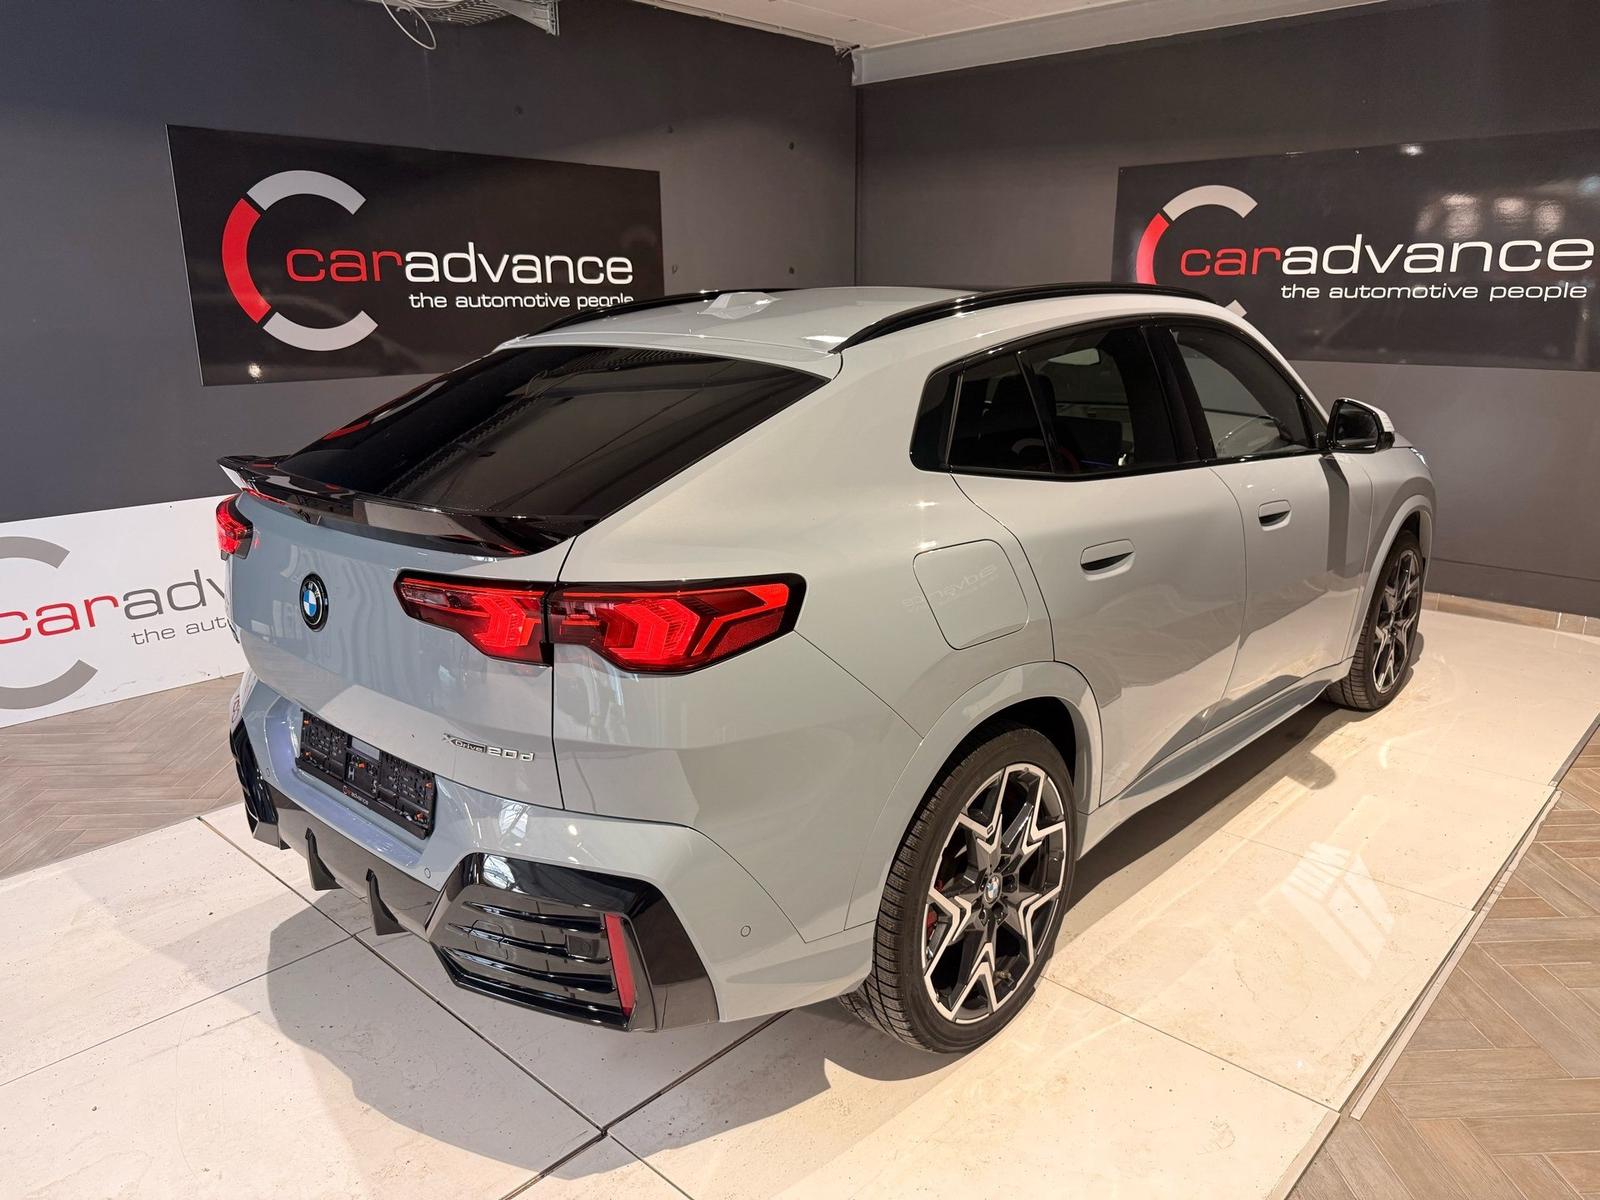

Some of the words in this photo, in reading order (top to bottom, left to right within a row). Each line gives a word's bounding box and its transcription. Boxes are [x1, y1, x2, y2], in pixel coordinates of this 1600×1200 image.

[285, 241, 634, 285] caradvance
[1179, 233, 1596, 276] caradvance
[408, 292, 448, 309] the
[455, 291, 571, 308] automotive
[1280, 283, 1320, 299] the
[1328, 282, 1479, 299] automotive
[1489, 281, 1588, 302] people
[131, 628, 176, 645] the
